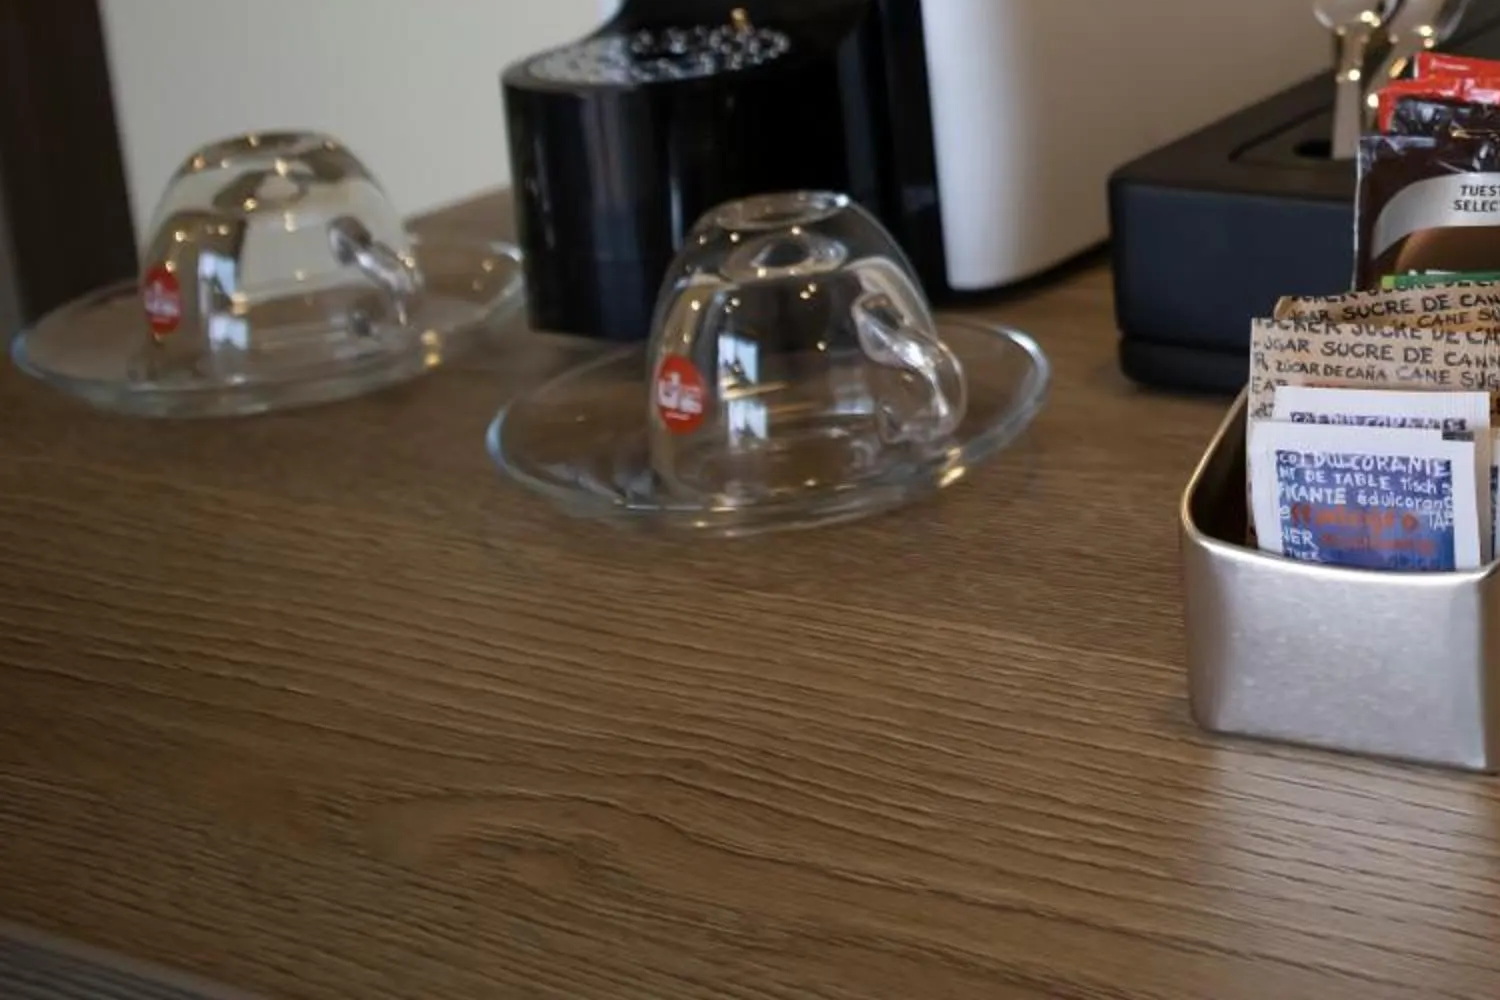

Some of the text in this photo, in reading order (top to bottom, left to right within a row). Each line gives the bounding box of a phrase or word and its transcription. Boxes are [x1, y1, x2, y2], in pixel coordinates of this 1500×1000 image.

[1343, 299, 1416, 320] SUCRE
[1421, 295, 1451, 312] DE
[1416, 312, 1471, 328] CANE
[1320, 341, 1394, 362] SUCRE
[1404, 347, 1433, 364] DE
[1323, 364, 1344, 377] DE
[1345, 364, 1387, 381] CAÑA
[1396, 366, 1451, 385] CANE
[1305, 468, 1326, 482] DE
[1335, 472, 1391, 490] TABLE
